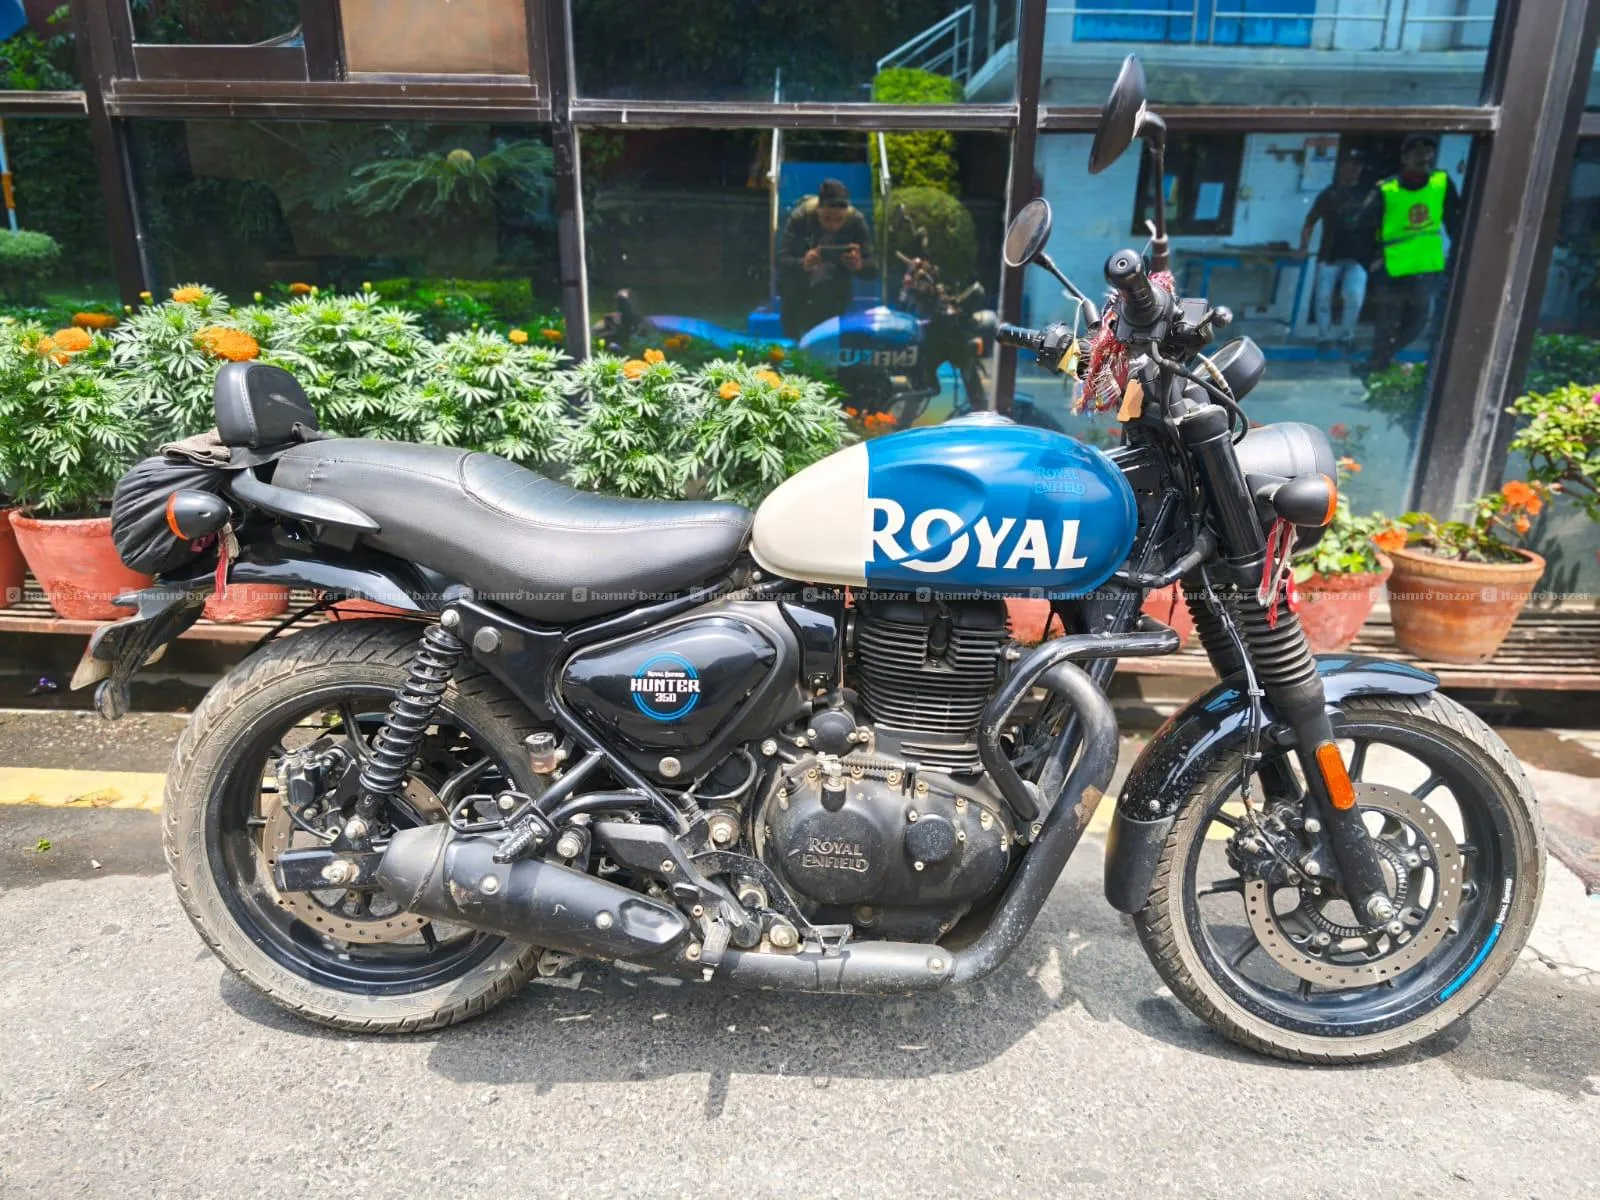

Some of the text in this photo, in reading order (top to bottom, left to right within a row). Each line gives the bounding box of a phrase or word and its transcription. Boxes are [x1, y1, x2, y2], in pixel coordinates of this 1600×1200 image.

[1033, 480, 1087, 496] ENFIELD
[866, 498, 1088, 573] ROYAL
[630, 678, 701, 693] HUNTER
[655, 692, 677, 703] 350
[808, 837, 863, 856] ROYAL
[802, 853, 870, 873] ENFIELD
